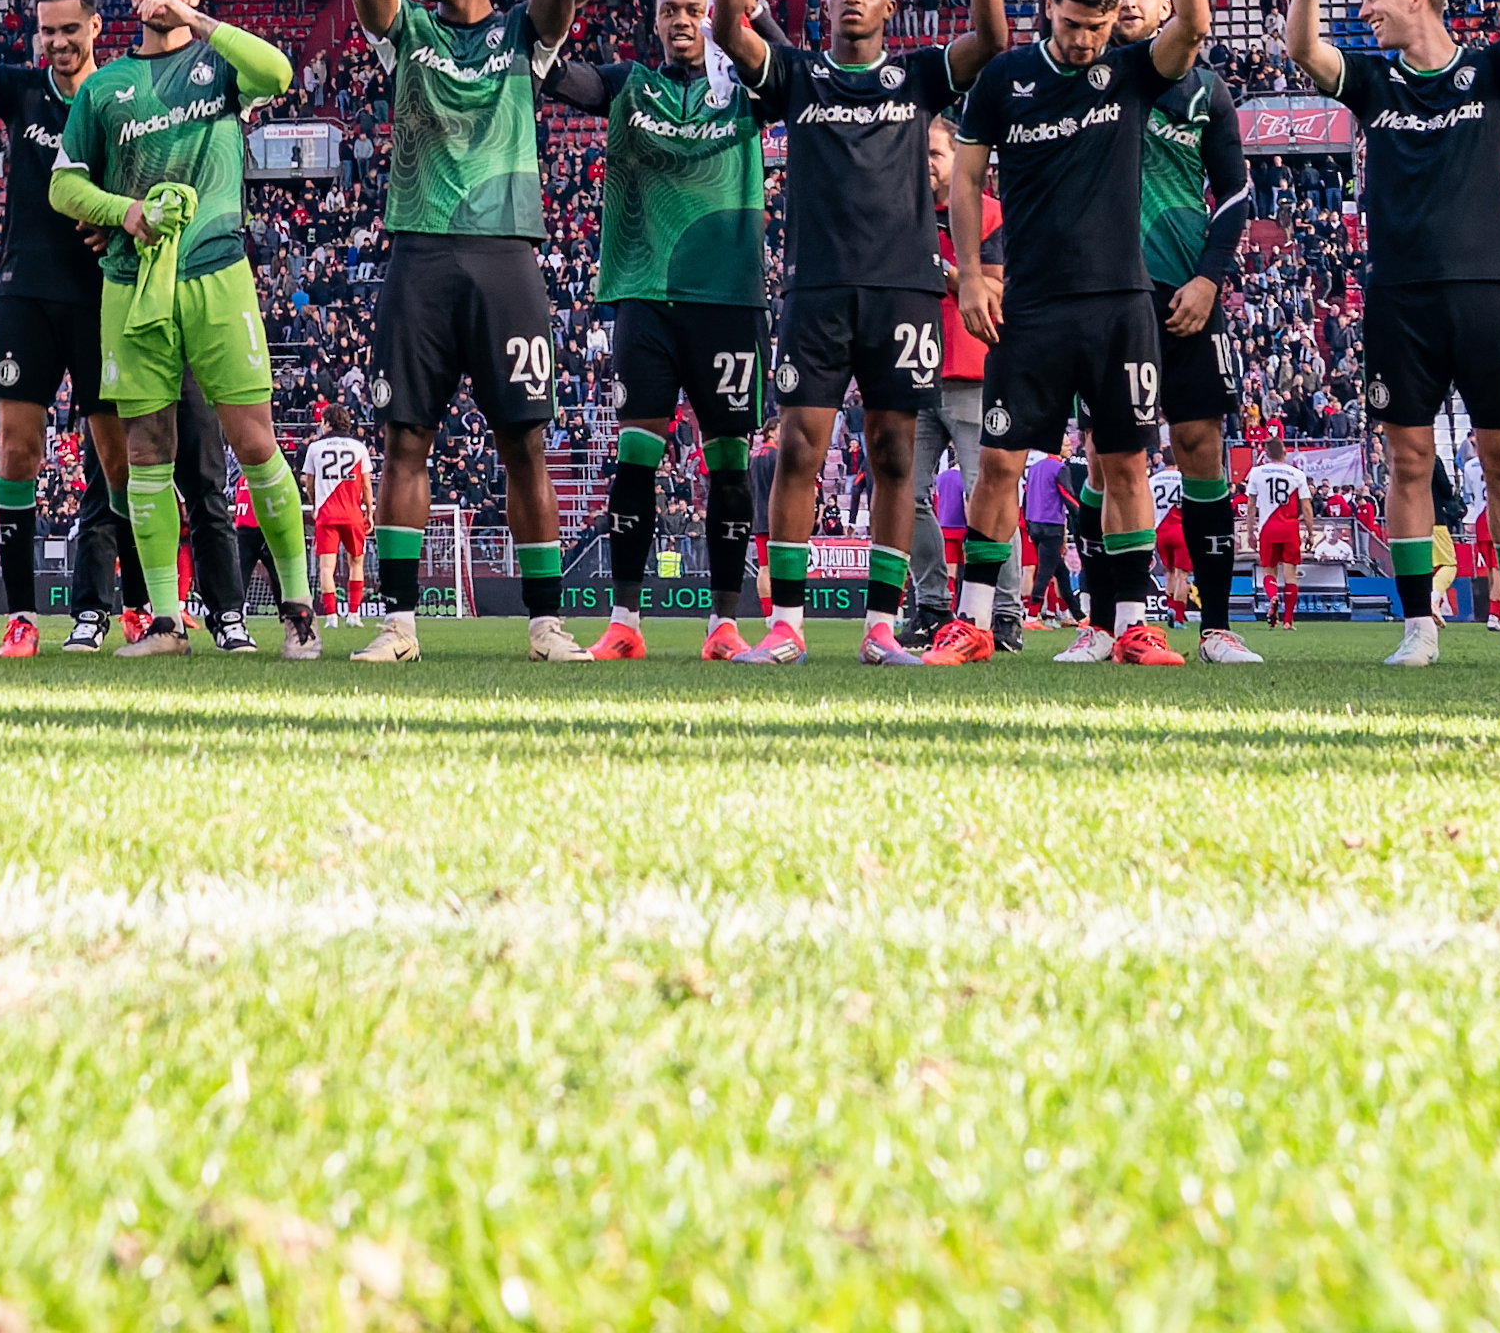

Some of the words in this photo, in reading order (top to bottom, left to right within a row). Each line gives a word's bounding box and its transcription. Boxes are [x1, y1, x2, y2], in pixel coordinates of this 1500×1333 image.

[1265, 111, 1314, 137] Bud
[242, 310, 259, 351] 1
[894, 322, 940, 369] 26
[506, 335, 551, 383] 20
[1211, 333, 1235, 375] 18
[713, 351, 756, 394] 27
[1124, 361, 1158, 407] 19
[320, 450, 357, 481] 22
[1153, 484, 1182, 510] 24
[1265, 477, 1290, 506] 18
[820, 549, 853, 567] DAVID
[560, 587, 598, 609] ITS
[660, 587, 714, 609] JOB
